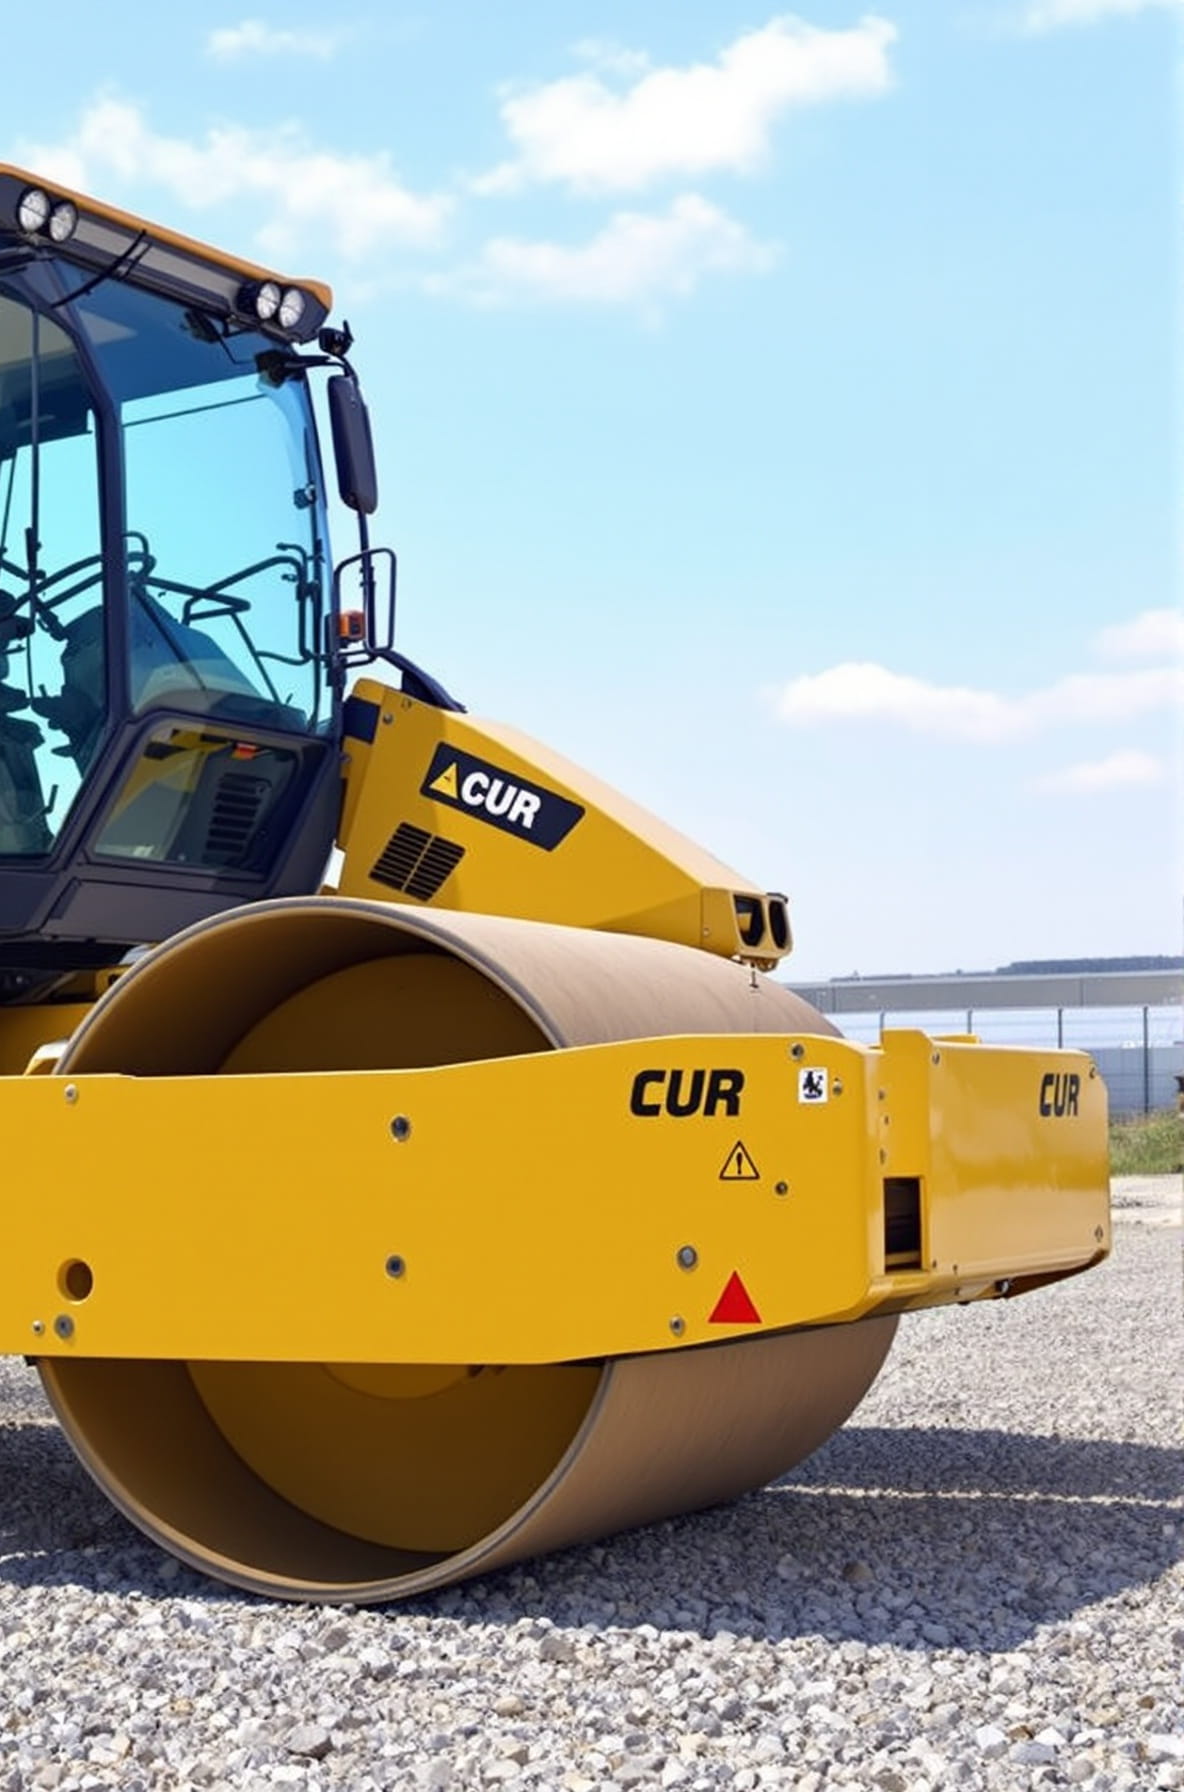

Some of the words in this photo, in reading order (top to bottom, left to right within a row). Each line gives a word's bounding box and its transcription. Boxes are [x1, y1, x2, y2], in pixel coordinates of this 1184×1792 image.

[461, 772, 541, 829] CUR
[630, 1069, 745, 1117] CUR
[1039, 1073, 1080, 1117] CUR
